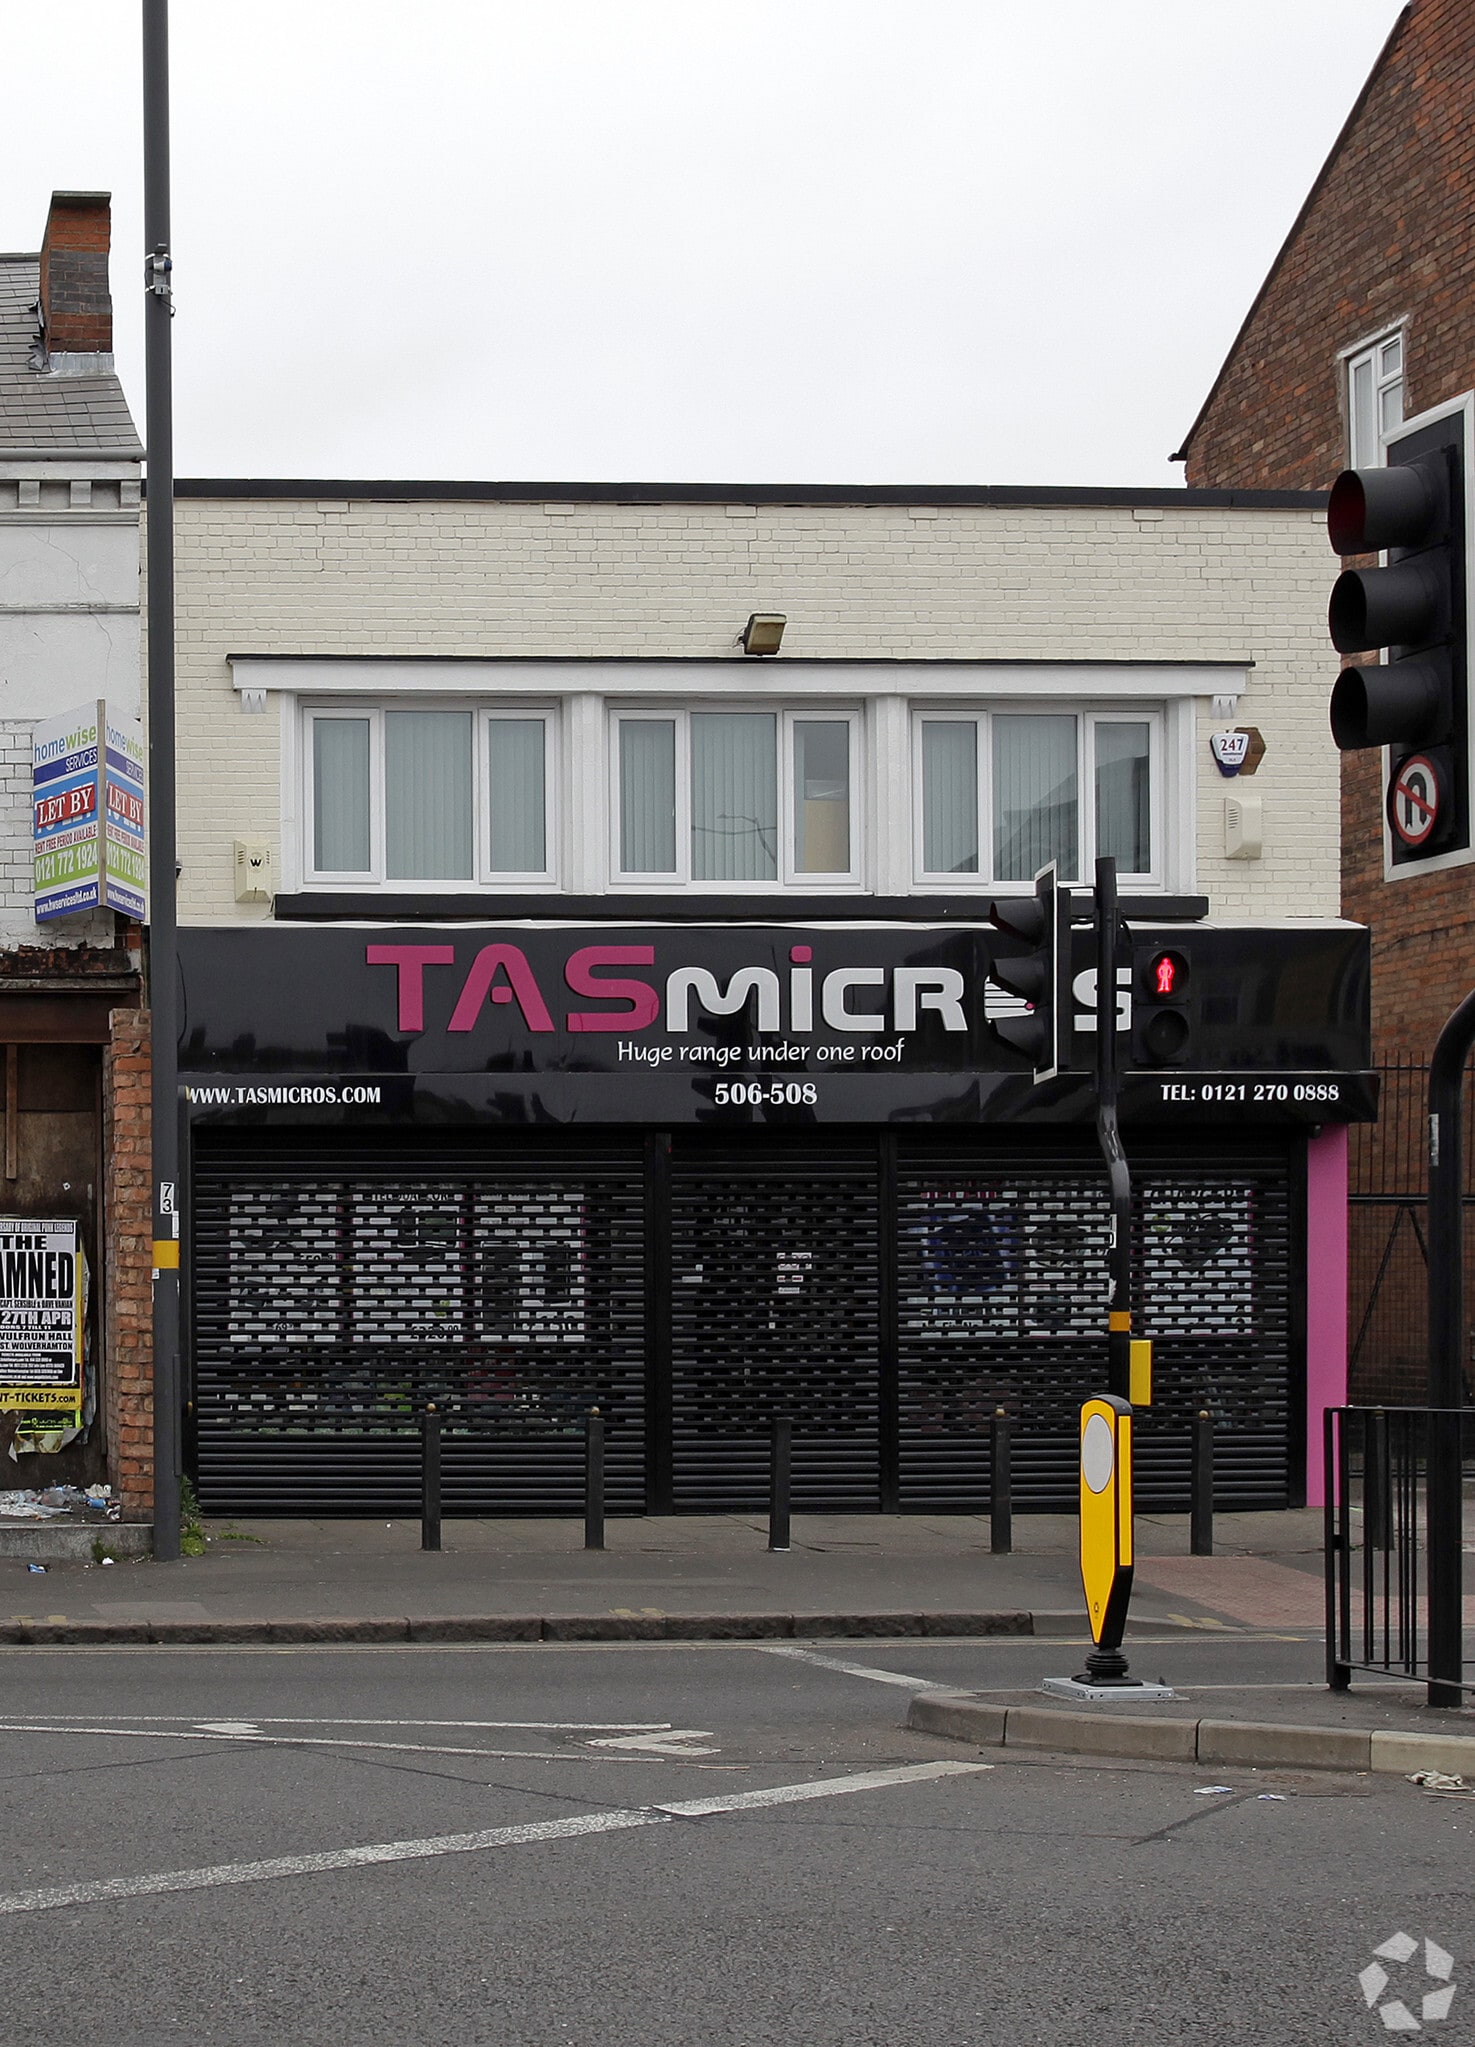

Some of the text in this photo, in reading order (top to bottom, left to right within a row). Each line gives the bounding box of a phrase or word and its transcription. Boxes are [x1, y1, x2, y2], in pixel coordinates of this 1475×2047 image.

[34, 725, 97, 763] homewise
[106, 720, 144, 762] homewise
[1220, 738, 1244, 751] 247
[65, 748, 97, 772] SERVICES
[38, 787, 93, 825] LET BY
[108, 785, 142, 822] LET BY
[35, 842, 97, 883] 0121 772 1924
[617, 1037, 905, 1067] Huge range under one roof
[188, 1086, 381, 1104] WWW.TASMICROS.COM
[714, 1083, 818, 1105] 506-508
[1160, 1084, 1340, 1101] TEL: 0121 270 0888
[0, 1235, 47, 1250] THE
[1, 1311, 72, 1325] 27TH APR
[48, 1332, 73, 1341] HALL
[0, 1392, 76, 1403] T-TICKETS.COM
